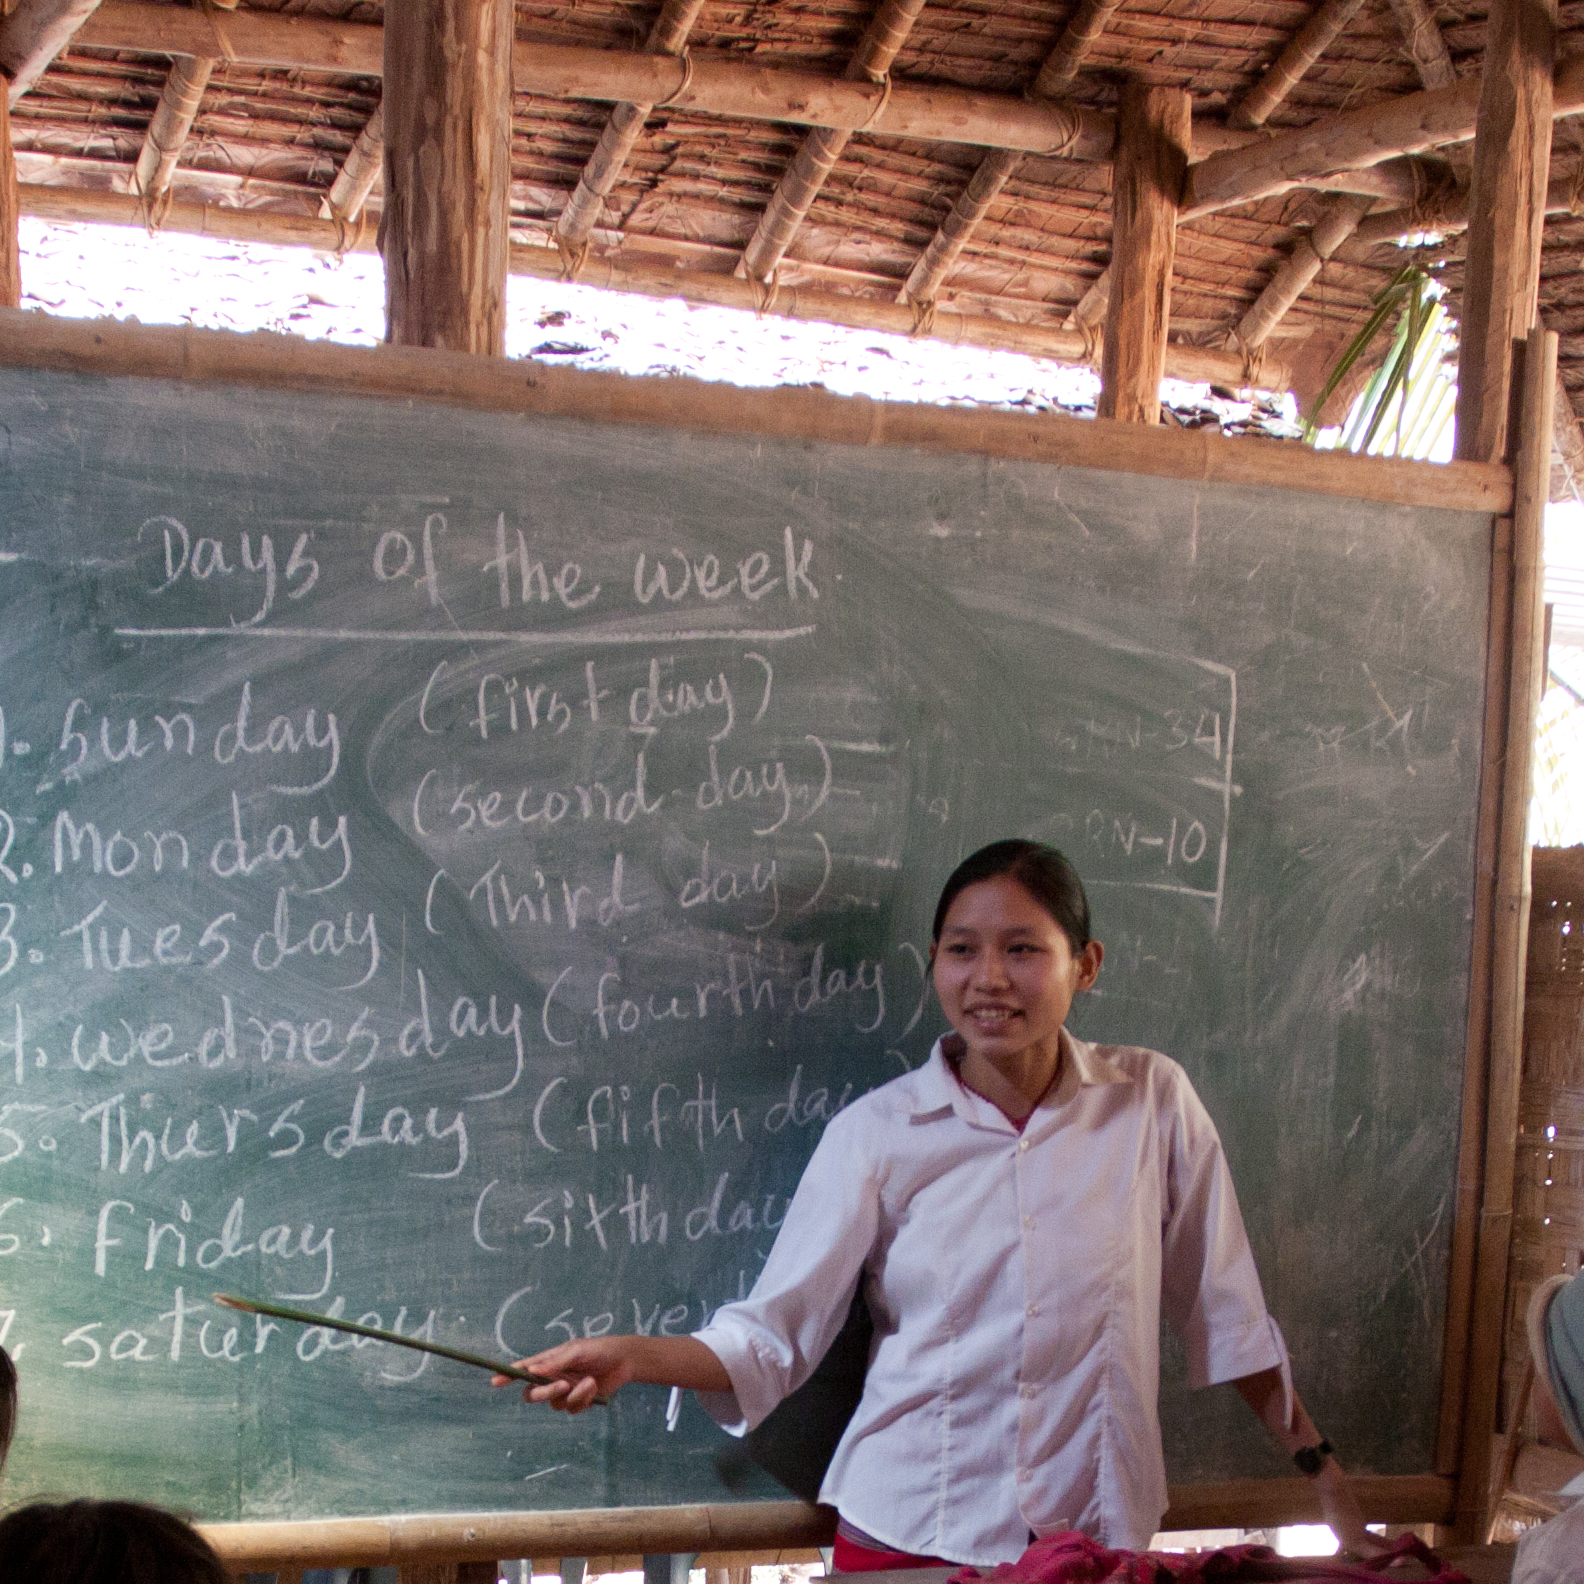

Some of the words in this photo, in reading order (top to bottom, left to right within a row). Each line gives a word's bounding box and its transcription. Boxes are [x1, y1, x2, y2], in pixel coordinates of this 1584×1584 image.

[138, 515, 318, 631] Days
[482, 511, 601, 609] the
[53, 790, 353, 895] Monday
[60, 887, 381, 991] Tuesday
[80, 1085, 469, 1179] Thursday
